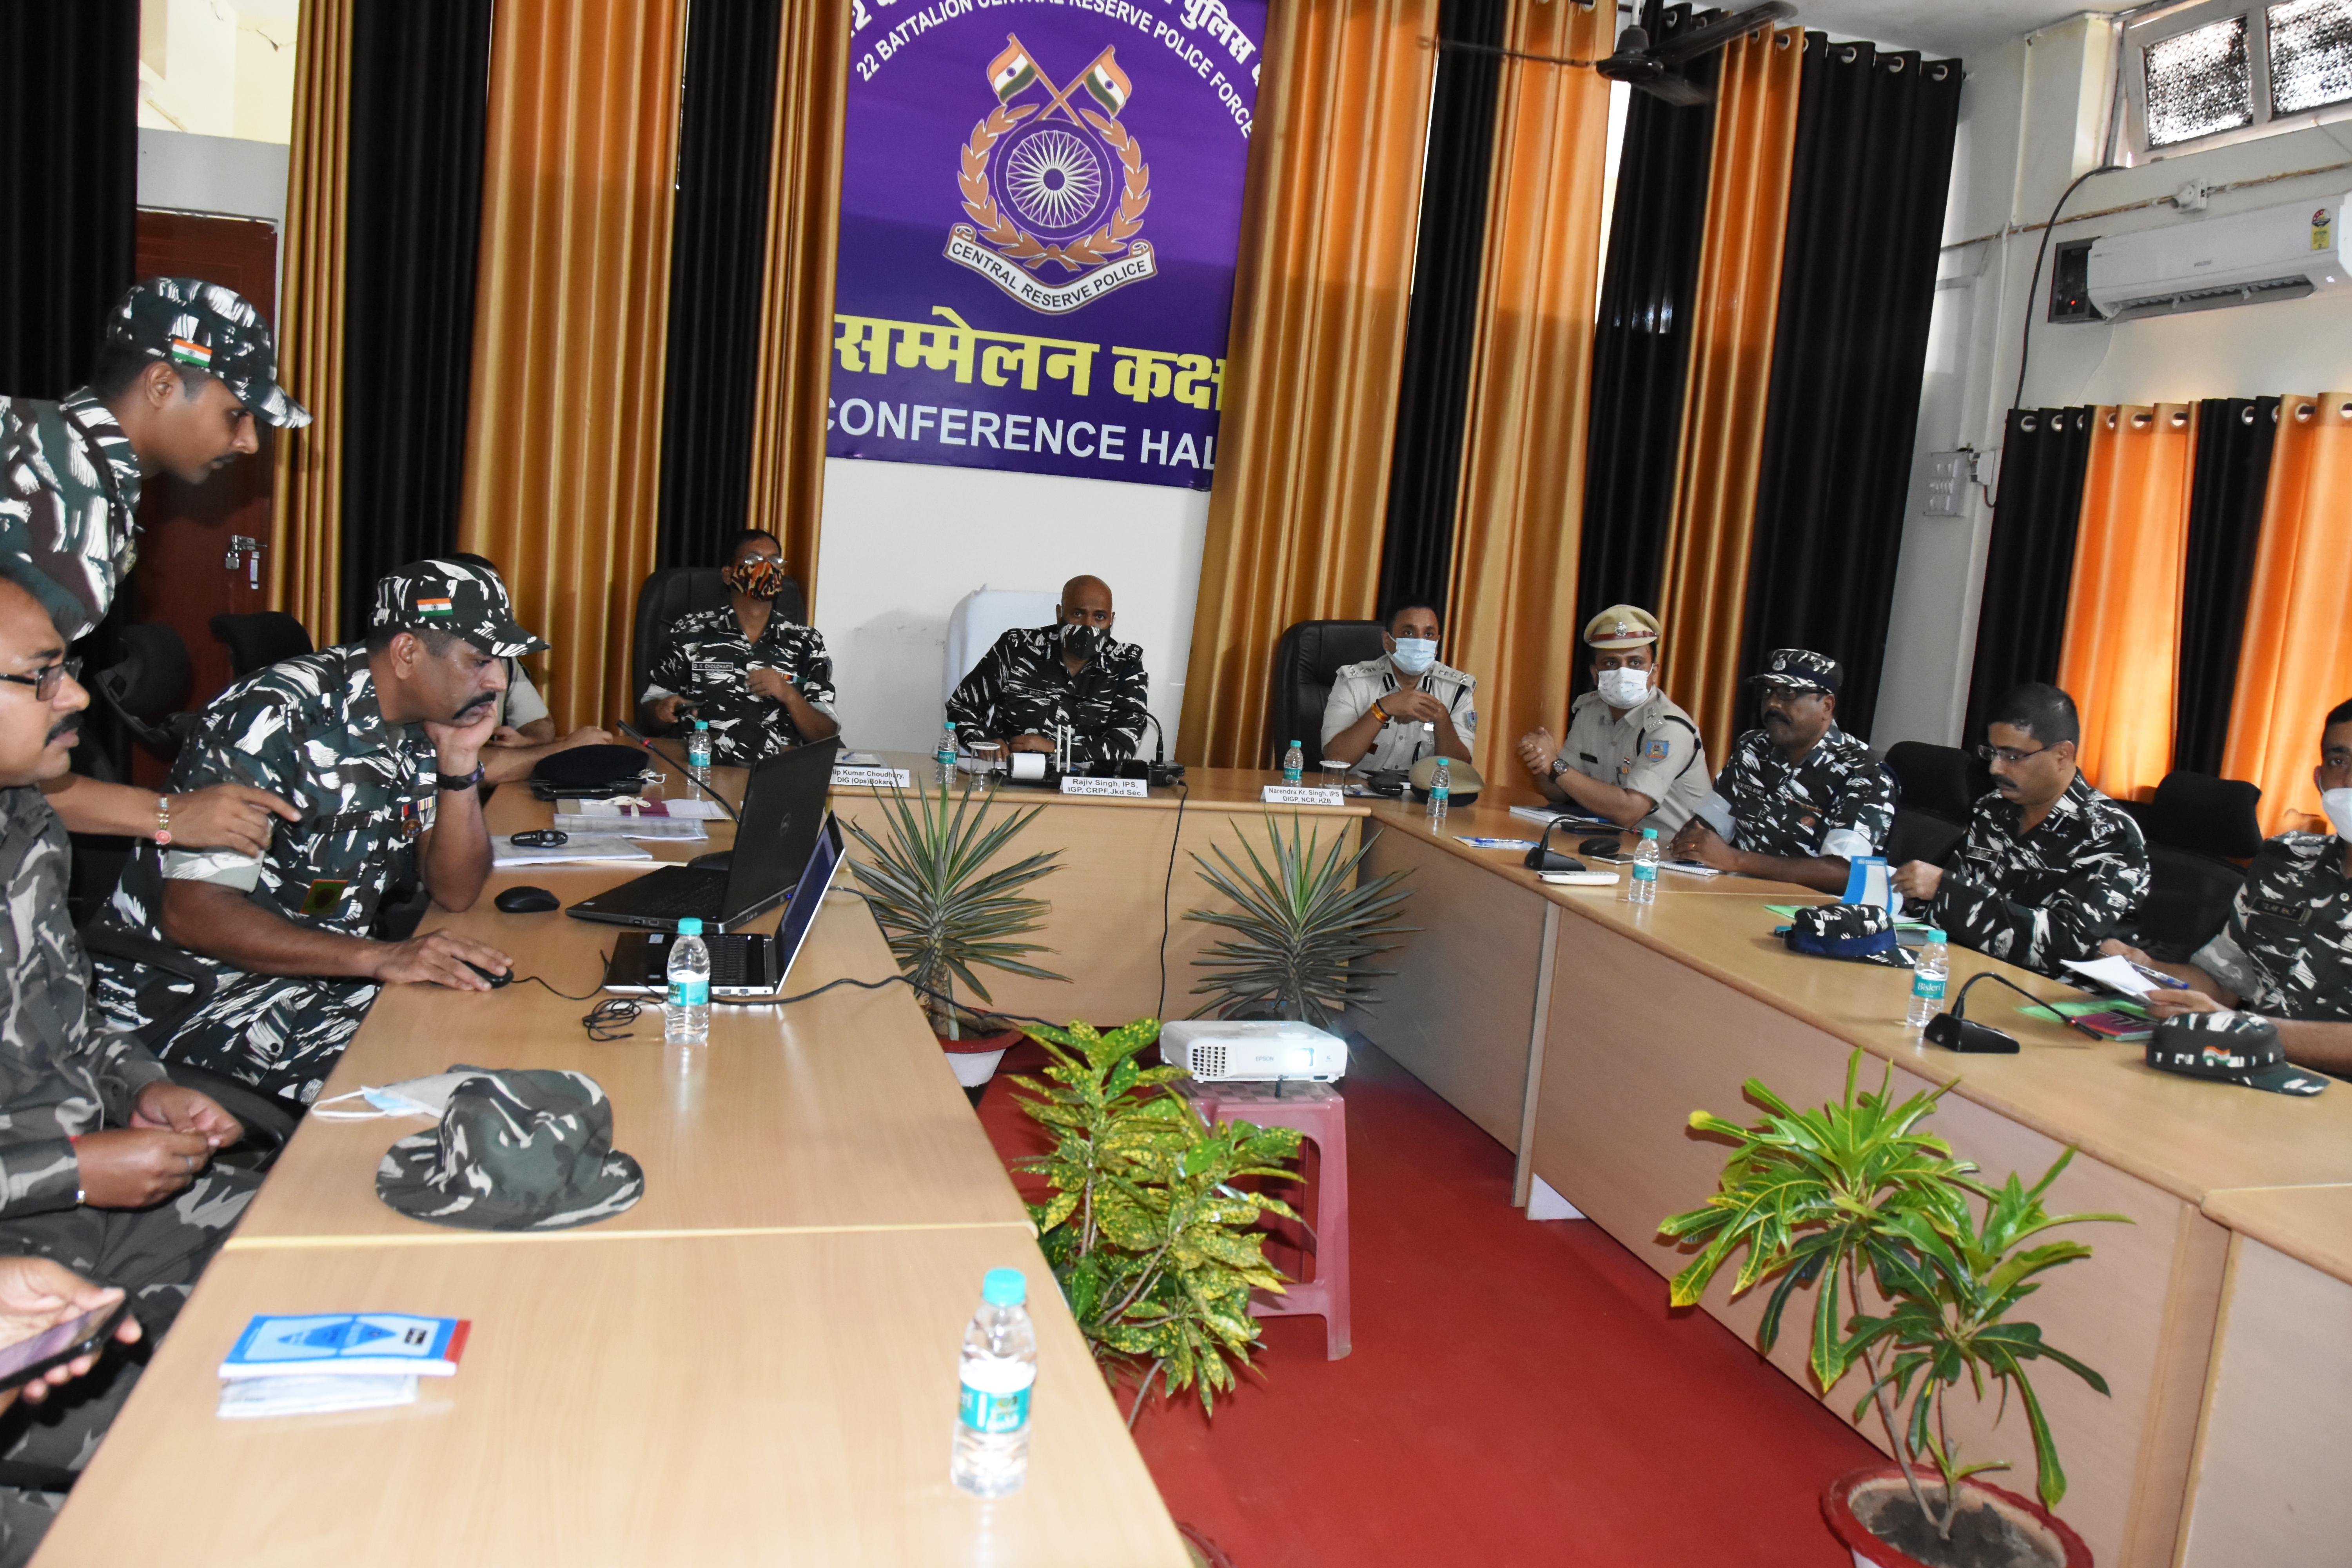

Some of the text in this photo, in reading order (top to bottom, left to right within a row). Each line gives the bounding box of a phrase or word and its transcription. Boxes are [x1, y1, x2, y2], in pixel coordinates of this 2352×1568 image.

[857, 53, 880, 82] 22
[875, 0, 973, 61] BATTALION
[1153, 20, 1214, 79] POLICE
[1210, 71, 1253, 139] FORCE
[952, 242, 1147, 308] CENTRAL RESERVE POLICE
[834, 305, 1226, 411] सम्मेलन कक्ष
[827, 397, 1126, 461] ONFERENCE
[1095, 780, 1120, 788] Singh,
[1918, 982, 1941, 991] Bisleri
